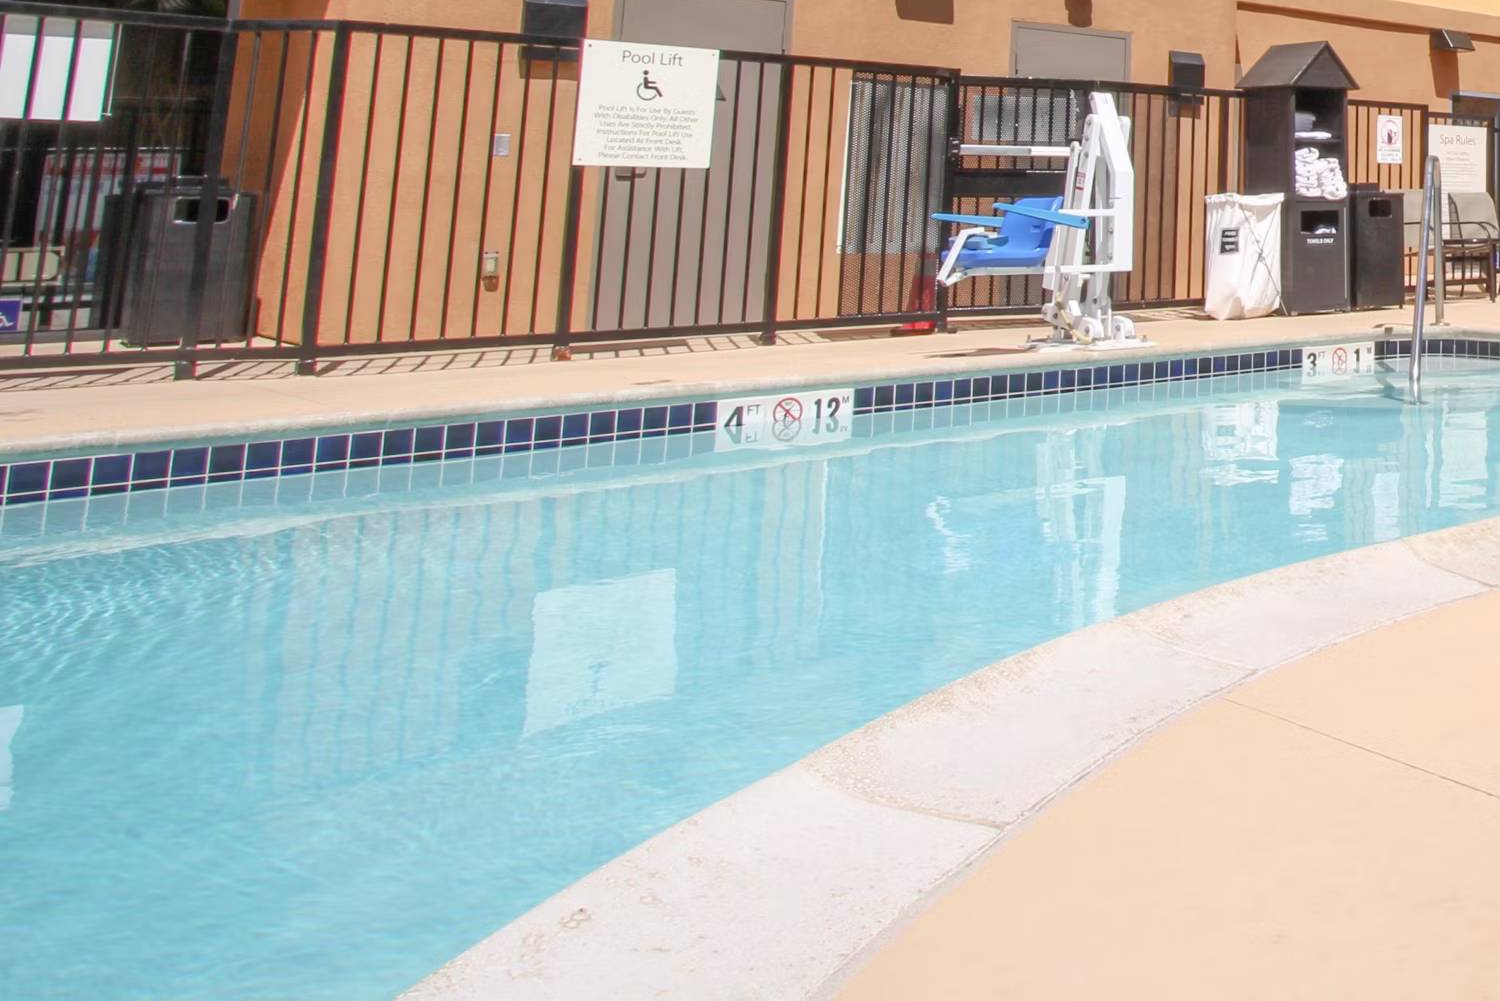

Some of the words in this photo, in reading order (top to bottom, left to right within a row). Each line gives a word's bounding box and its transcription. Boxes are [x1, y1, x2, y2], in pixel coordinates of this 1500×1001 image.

[622, 50, 656, 64] Pool
[660, 53, 683, 67] Lift
[1439, 135, 1453, 146] Spa
[1456, 135, 1476, 145] Rules
[724, 406, 746, 427] 4
[747, 404, 760, 416] FT
[842, 395, 850, 404] M
